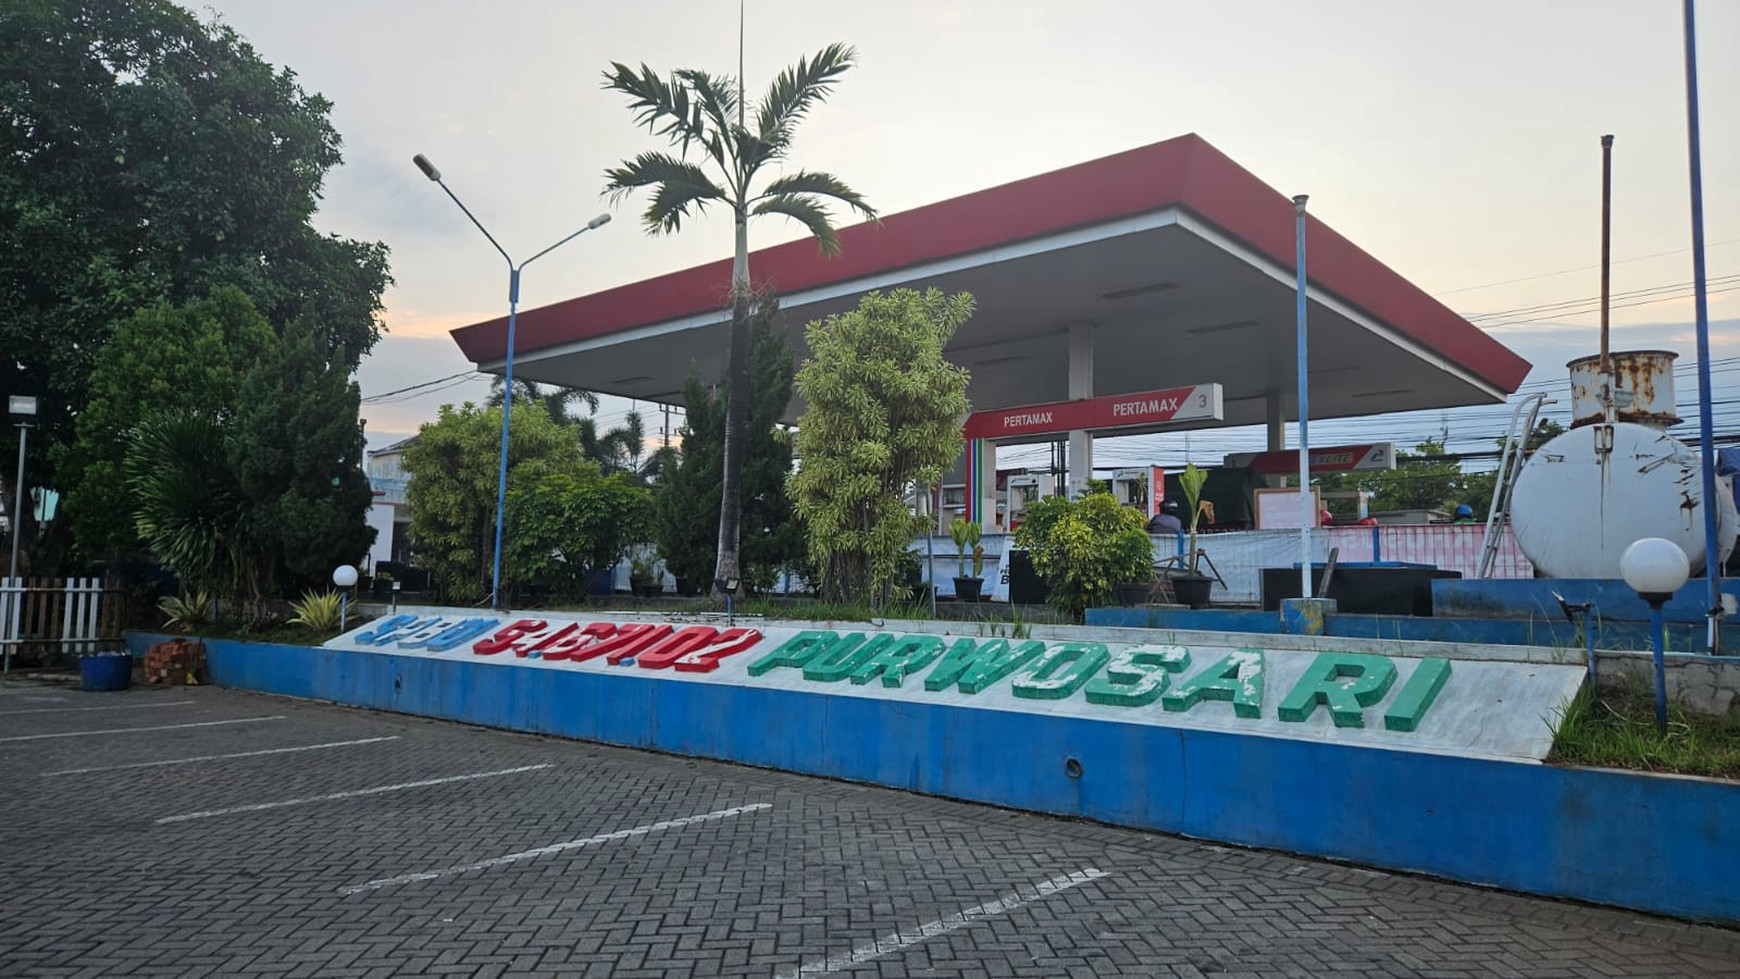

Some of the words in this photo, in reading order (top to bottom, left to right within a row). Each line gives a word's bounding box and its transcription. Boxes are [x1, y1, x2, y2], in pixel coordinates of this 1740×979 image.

[1113, 397, 1178, 417] PERTAMAX
[1198, 394, 1207, 409] 3
[1004, 412, 1053, 428] PERTAMAX
[354, 614, 500, 652] SPBU
[473, 619, 764, 673] 54.671.02
[747, 630, 1452, 732] PURWOSARI
